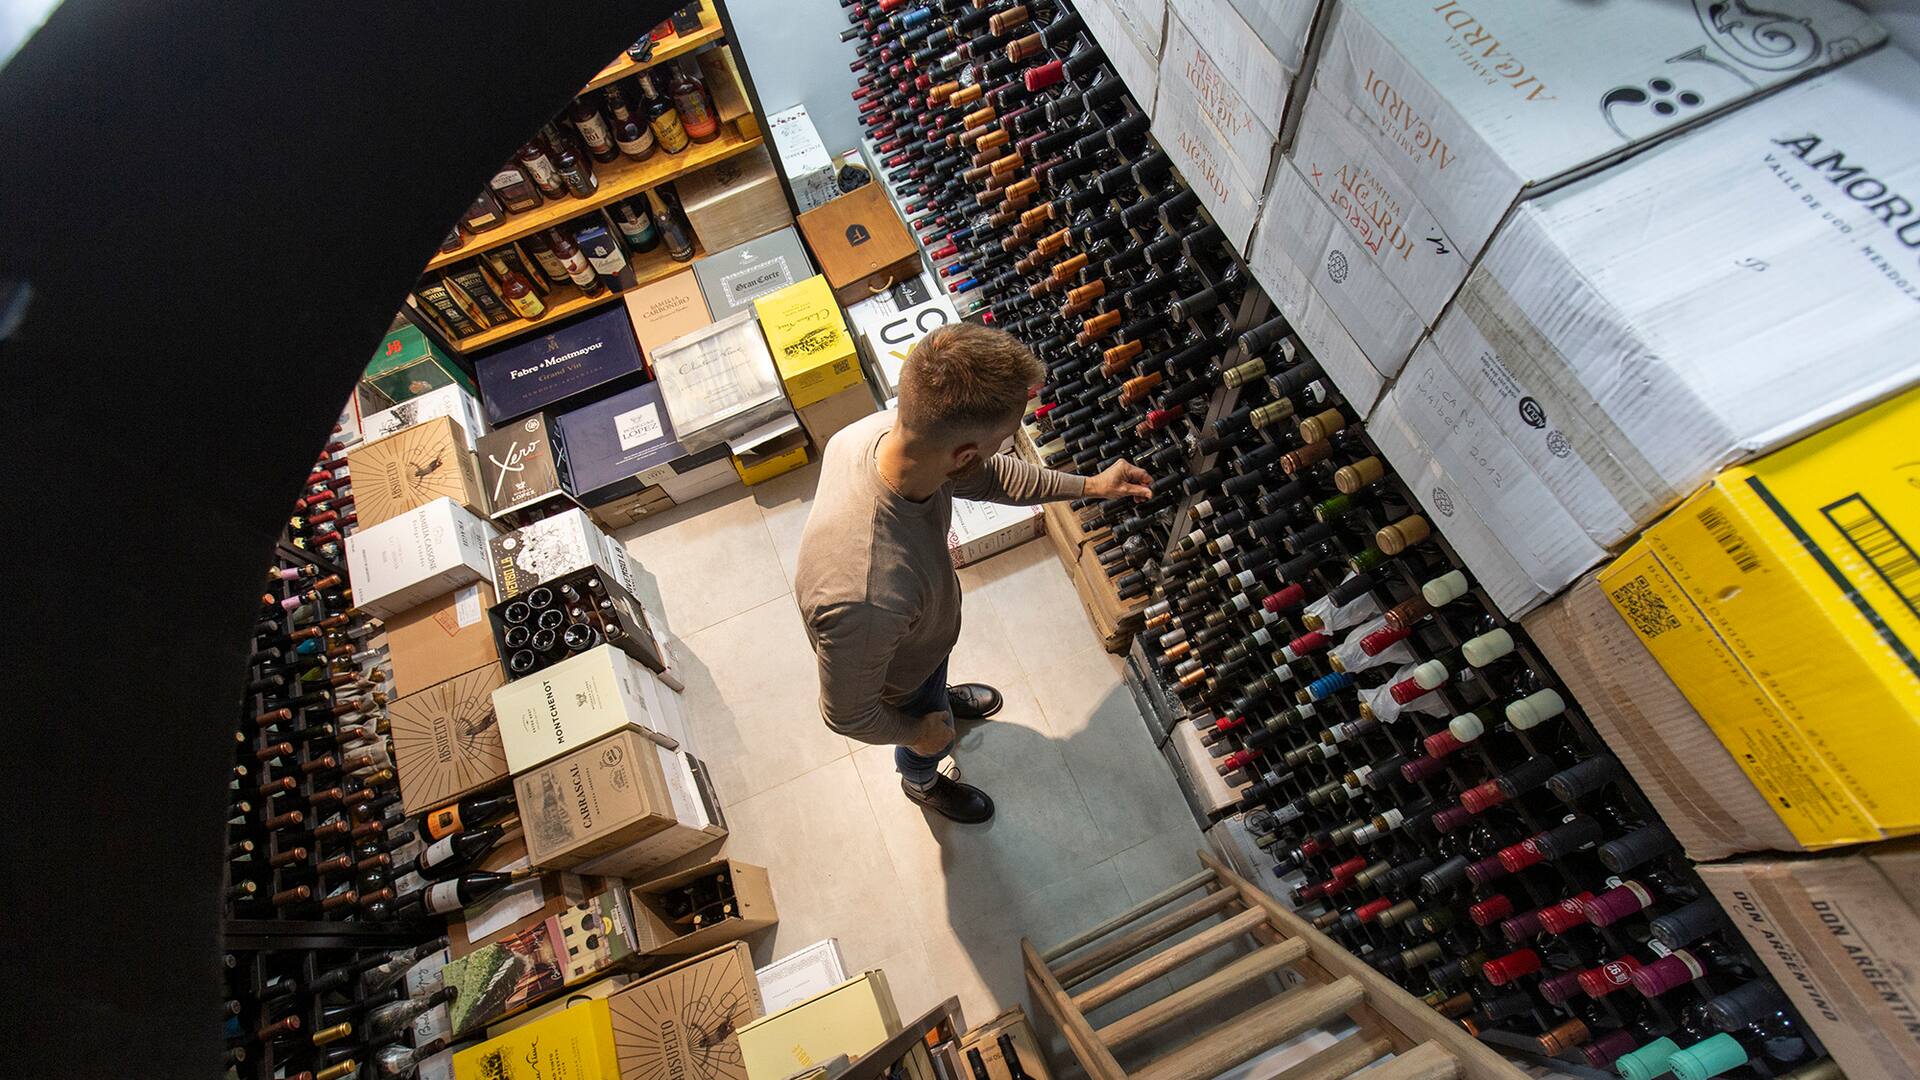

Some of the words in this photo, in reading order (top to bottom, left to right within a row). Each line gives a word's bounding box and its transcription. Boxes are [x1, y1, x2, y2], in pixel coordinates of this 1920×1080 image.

[1185, 60, 1243, 137] AIGARDI
[1362, 68, 1457, 171] AIGARDI
[1177, 131, 1229, 205] AIGARDI
[1381, 116, 1422, 164] FAMILIA
[1334, 164, 1415, 262] AIGARDI
[1363, 168, 1402, 217] FAMILIA
[1762, 153, 1802, 194] VALLE
[1800, 193, 1824, 212] DE
[1820, 212, 1852, 236] UCO
[735, 275, 758, 292] Gran
[757, 270, 781, 284] Corte
[509, 365, 539, 381] Fabre
[538, 367, 567, 382] Grand
[567, 361, 583, 373] Vin
[621, 422, 659, 440] LOPEZ
[488, 439, 541, 502] Xero
[424, 541, 438, 571] CASSONE
[1652, 535, 1691, 581] LOPEZ
[1646, 564, 1705, 633] BODEGAS
[1706, 638, 1749, 688] LOPEZ
[1692, 587, 1756, 660] BODEGAS
[432, 716, 454, 765] ABSUELTO
[542, 679, 565, 745] MONTCHENOT
[569, 762, 592, 830] CARRASCAL
[1811, 900, 1850, 937] DON
[1733, 891, 1764, 923] DON
[1761, 929, 1839, 1022] ARGENTINO
